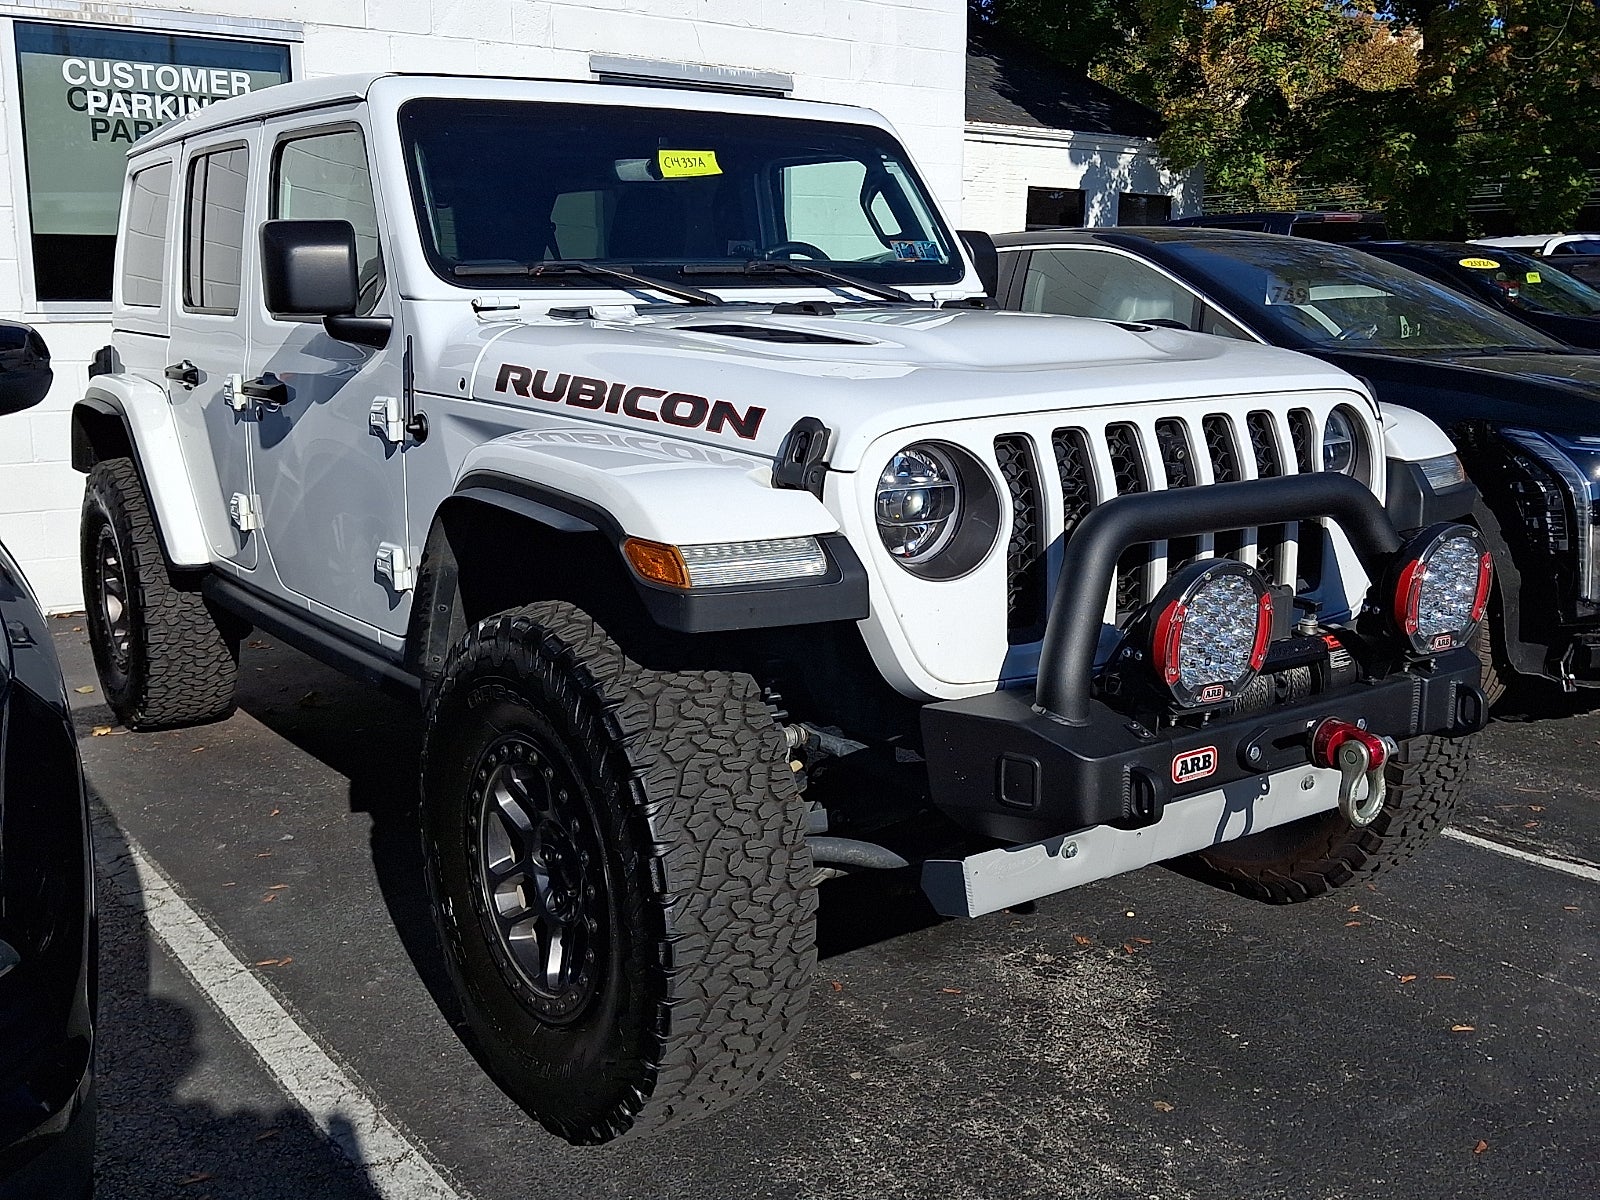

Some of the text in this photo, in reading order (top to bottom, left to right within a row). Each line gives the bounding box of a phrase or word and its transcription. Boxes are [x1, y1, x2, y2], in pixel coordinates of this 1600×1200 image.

[62, 58, 251, 96] CUSTOMER
[495, 363, 767, 441] RUBICON
[1189, 651, 1250, 669] SOLIS
[1205, 688, 1222, 699] ARB
[1178, 754, 1212, 776] ARB
